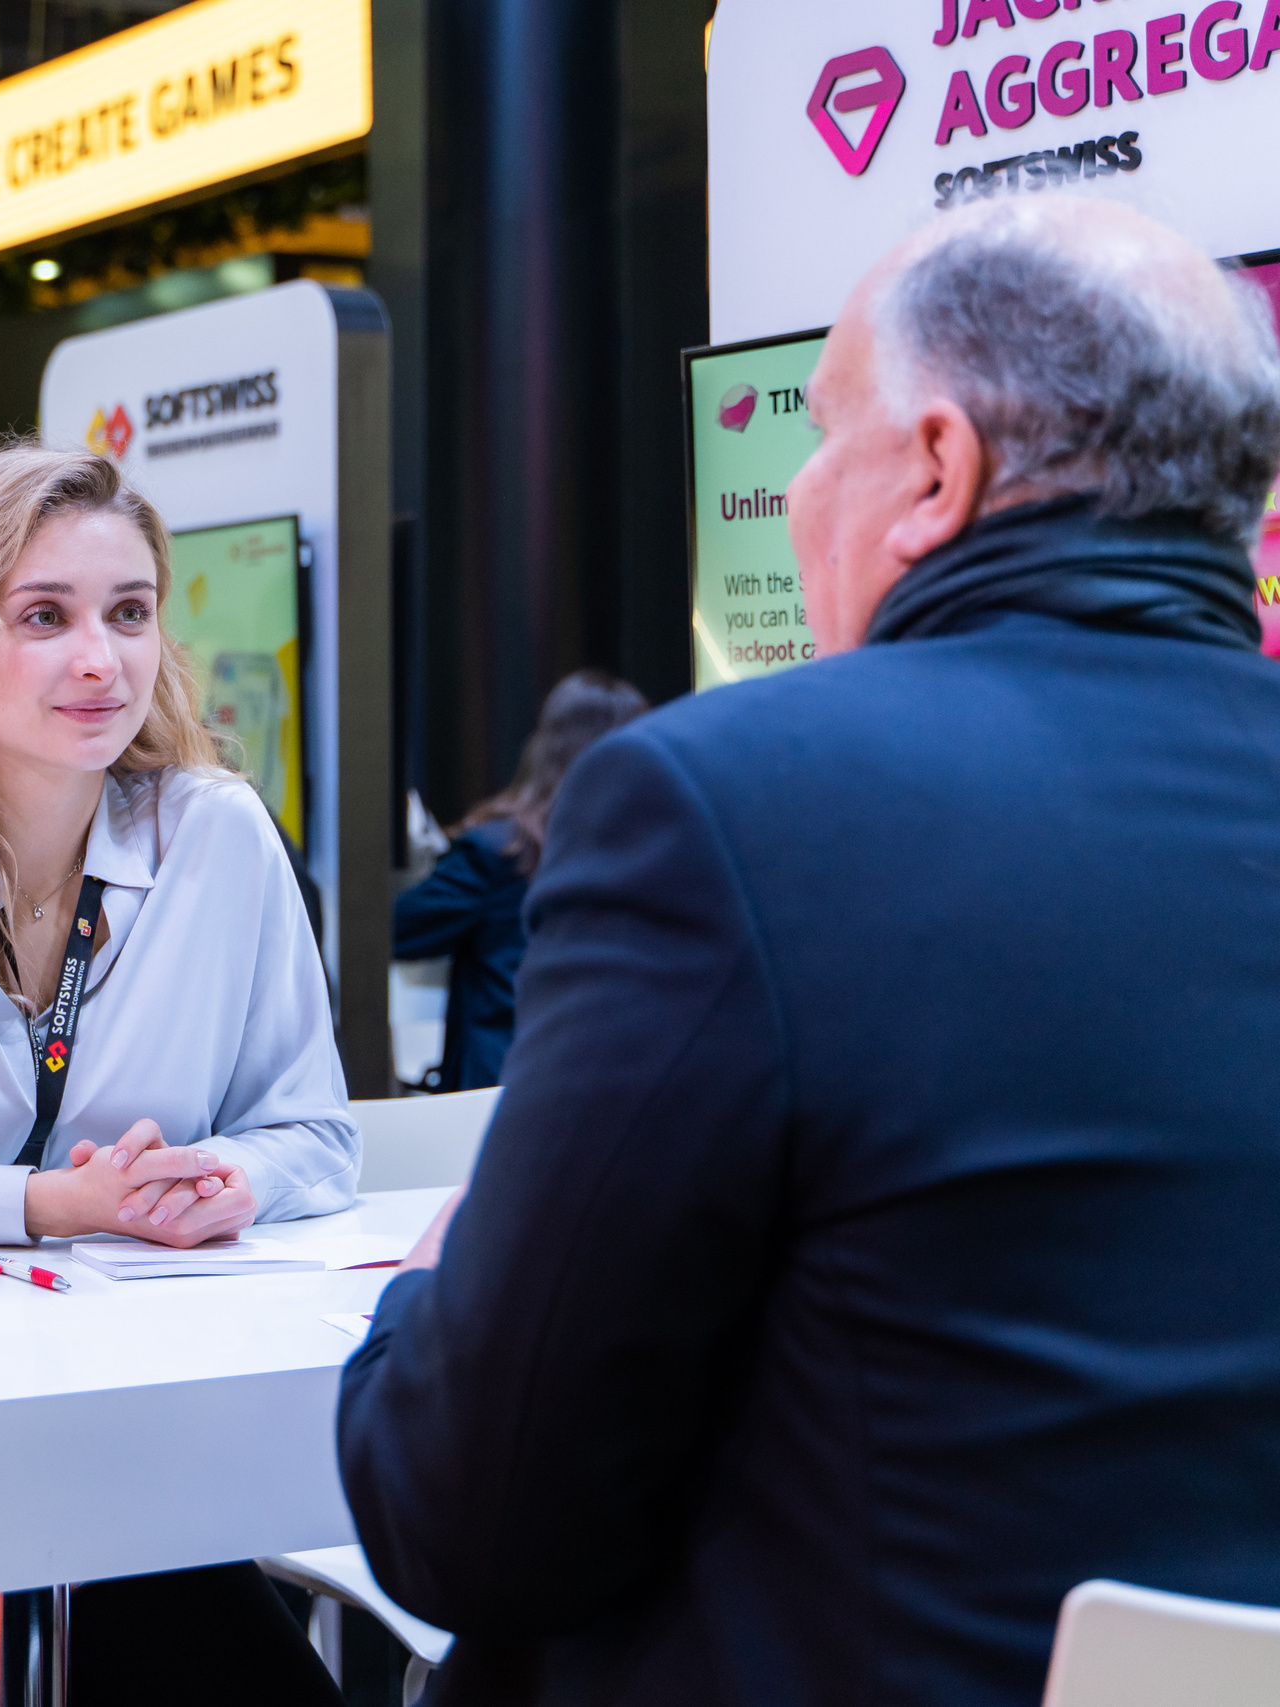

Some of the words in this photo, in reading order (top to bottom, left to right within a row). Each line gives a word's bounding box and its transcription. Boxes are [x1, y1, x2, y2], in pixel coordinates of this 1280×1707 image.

[4, 92, 138, 193] CREATE
[148, 31, 303, 139] GAMES
[144, 370, 278, 430] SOFTSWISS
[724, 573, 761, 596] With
[767, 571, 793, 594] the
[725, 611, 754, 635] you
[760, 609, 788, 628] can
[728, 639, 795, 667] jackpot
[51, 957, 78, 1035] SOFTSWISS
[66, 1006, 77, 1037] WINNING
[72, 960, 86, 1007] COMBINATION
